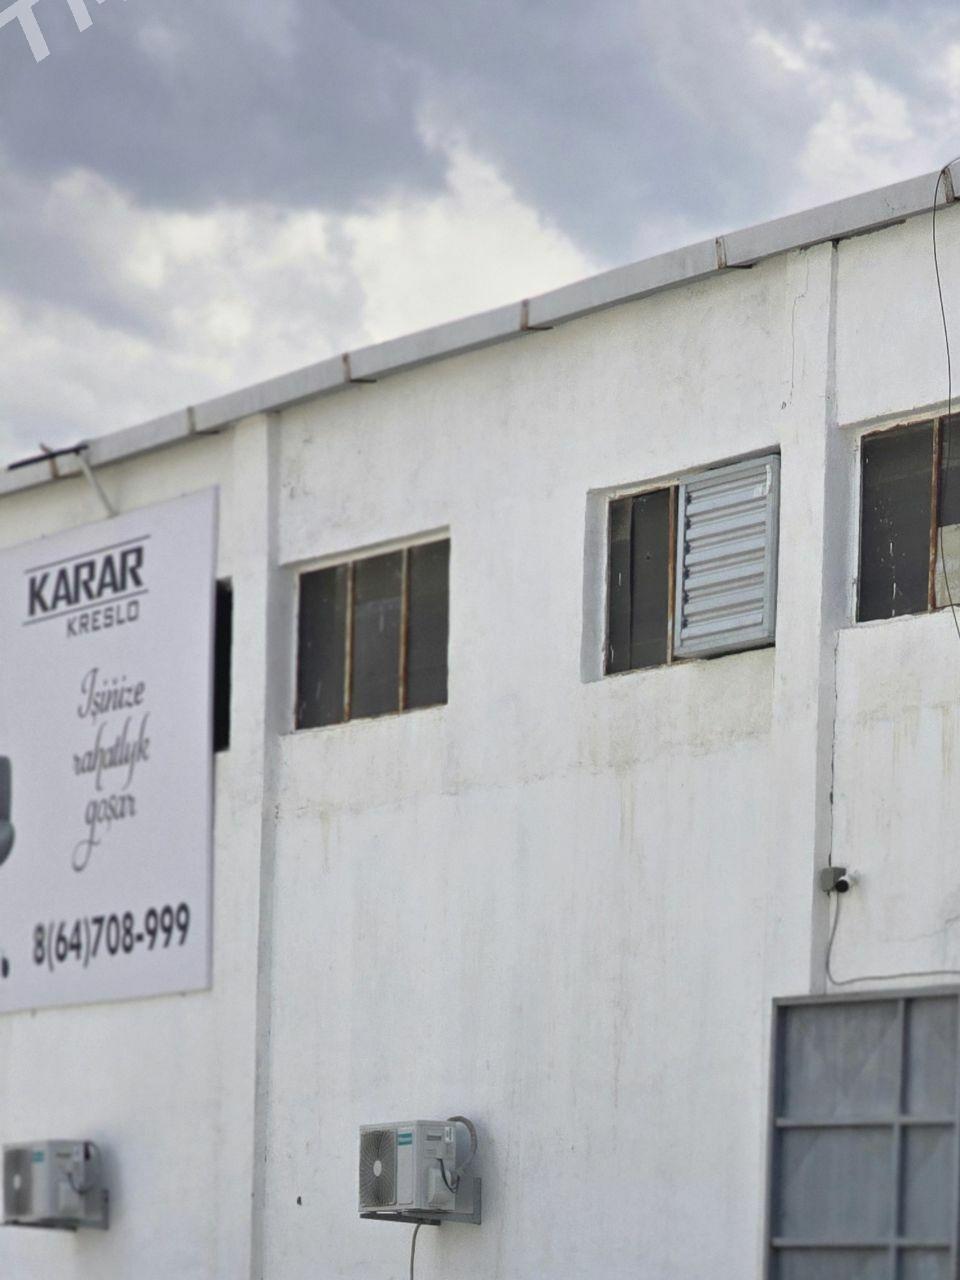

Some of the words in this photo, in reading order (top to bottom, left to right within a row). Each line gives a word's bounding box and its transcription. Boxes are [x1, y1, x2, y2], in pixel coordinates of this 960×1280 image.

[28, 546, 145, 616] KARAR
[66, 599, 140, 637] KRESLO
[33, 902, 190, 972] 8(64)708-999
